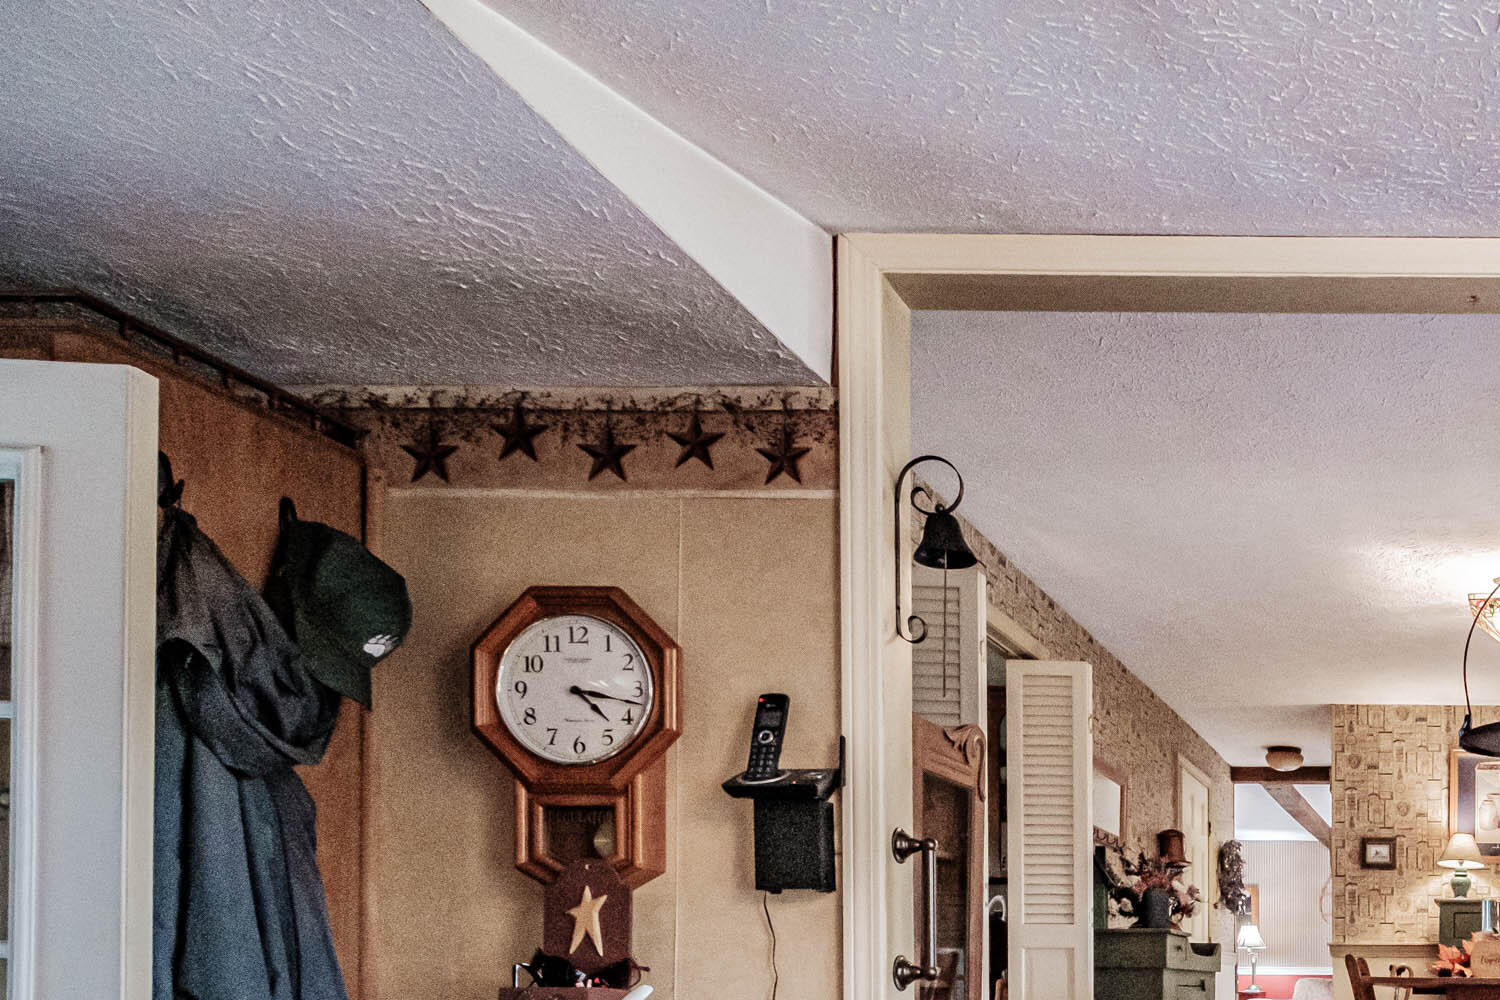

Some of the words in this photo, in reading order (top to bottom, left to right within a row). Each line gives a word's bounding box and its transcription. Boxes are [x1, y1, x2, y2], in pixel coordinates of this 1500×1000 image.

[543, 635, 560, 652] 11
[568, 626, 589, 644] 12
[605, 635, 614, 652] 1
[524, 655, 544, 673] 10
[623, 654, 634, 670] 2
[515, 681, 528, 698] 9
[632, 681, 643, 697] 3
[523, 707, 537, 725] 8
[621, 708, 634, 725] 4
[547, 728, 559, 745] 7
[573, 736, 586, 754] 6
[602, 729, 614, 745] 5
